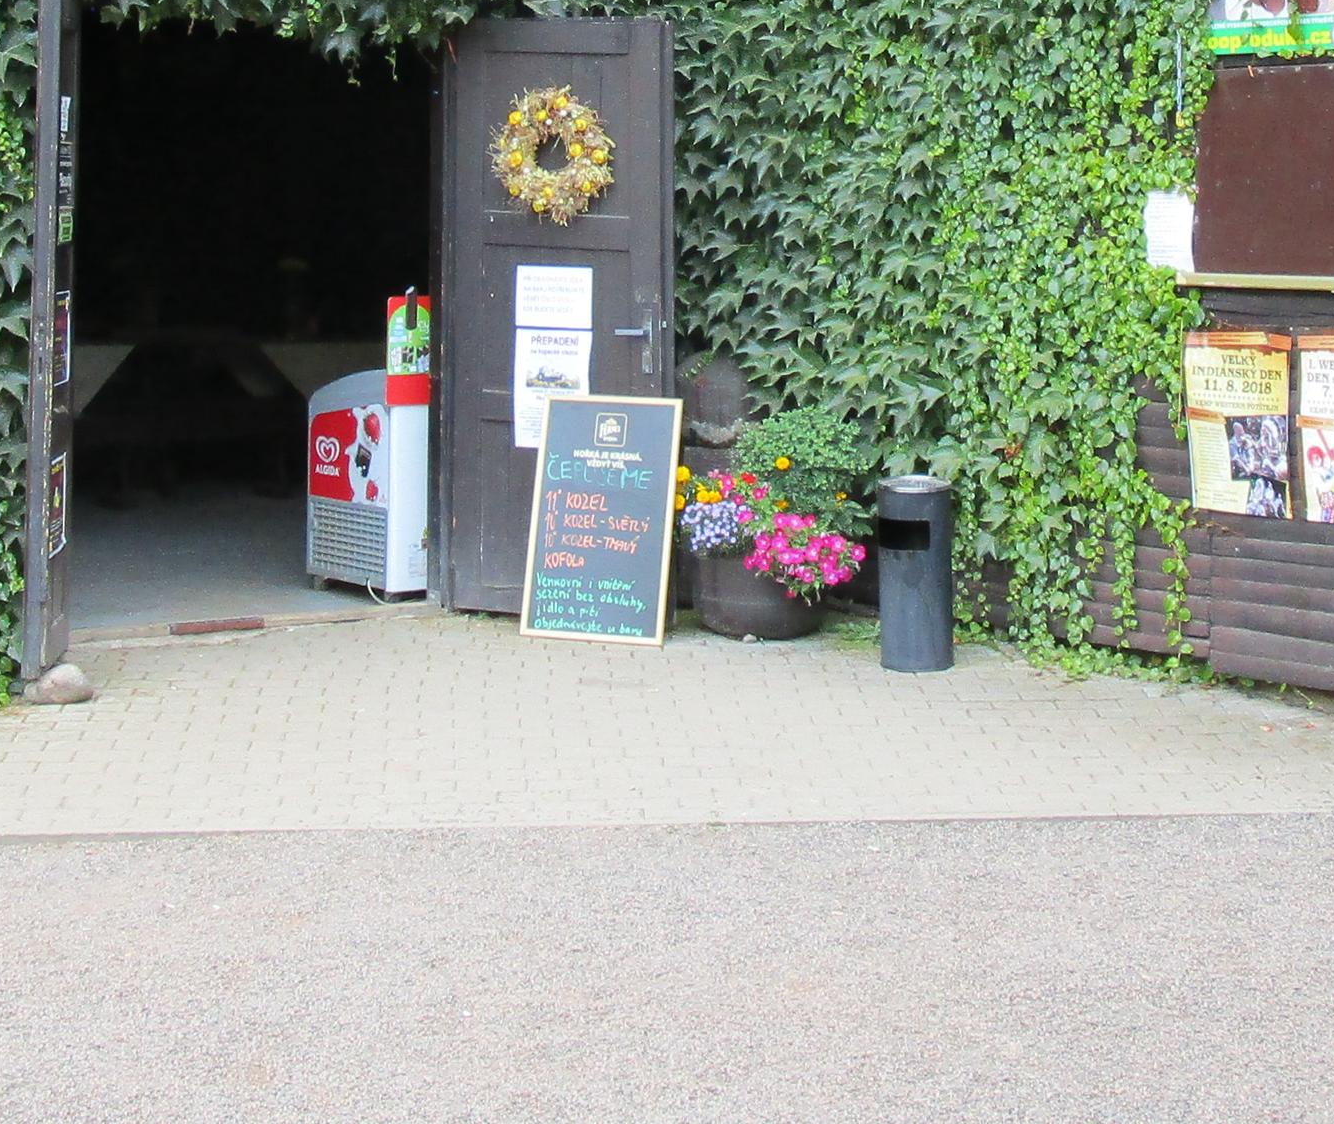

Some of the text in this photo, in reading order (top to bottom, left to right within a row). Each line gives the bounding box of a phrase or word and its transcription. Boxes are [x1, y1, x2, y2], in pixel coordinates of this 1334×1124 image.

[530, 334, 579, 347] PŘEPADENÍ
[1259, 369, 1283, 381] DEN
[1306, 372, 1330, 384] DEN
[1204, 378, 1273, 395] 11. 8. 2018
[314, 463, 341, 477] ALGIDA
[565, 491, 609, 512] KOZEL
[563, 513, 598, 530] KOZEL
[575, 589, 595, 603] bez
